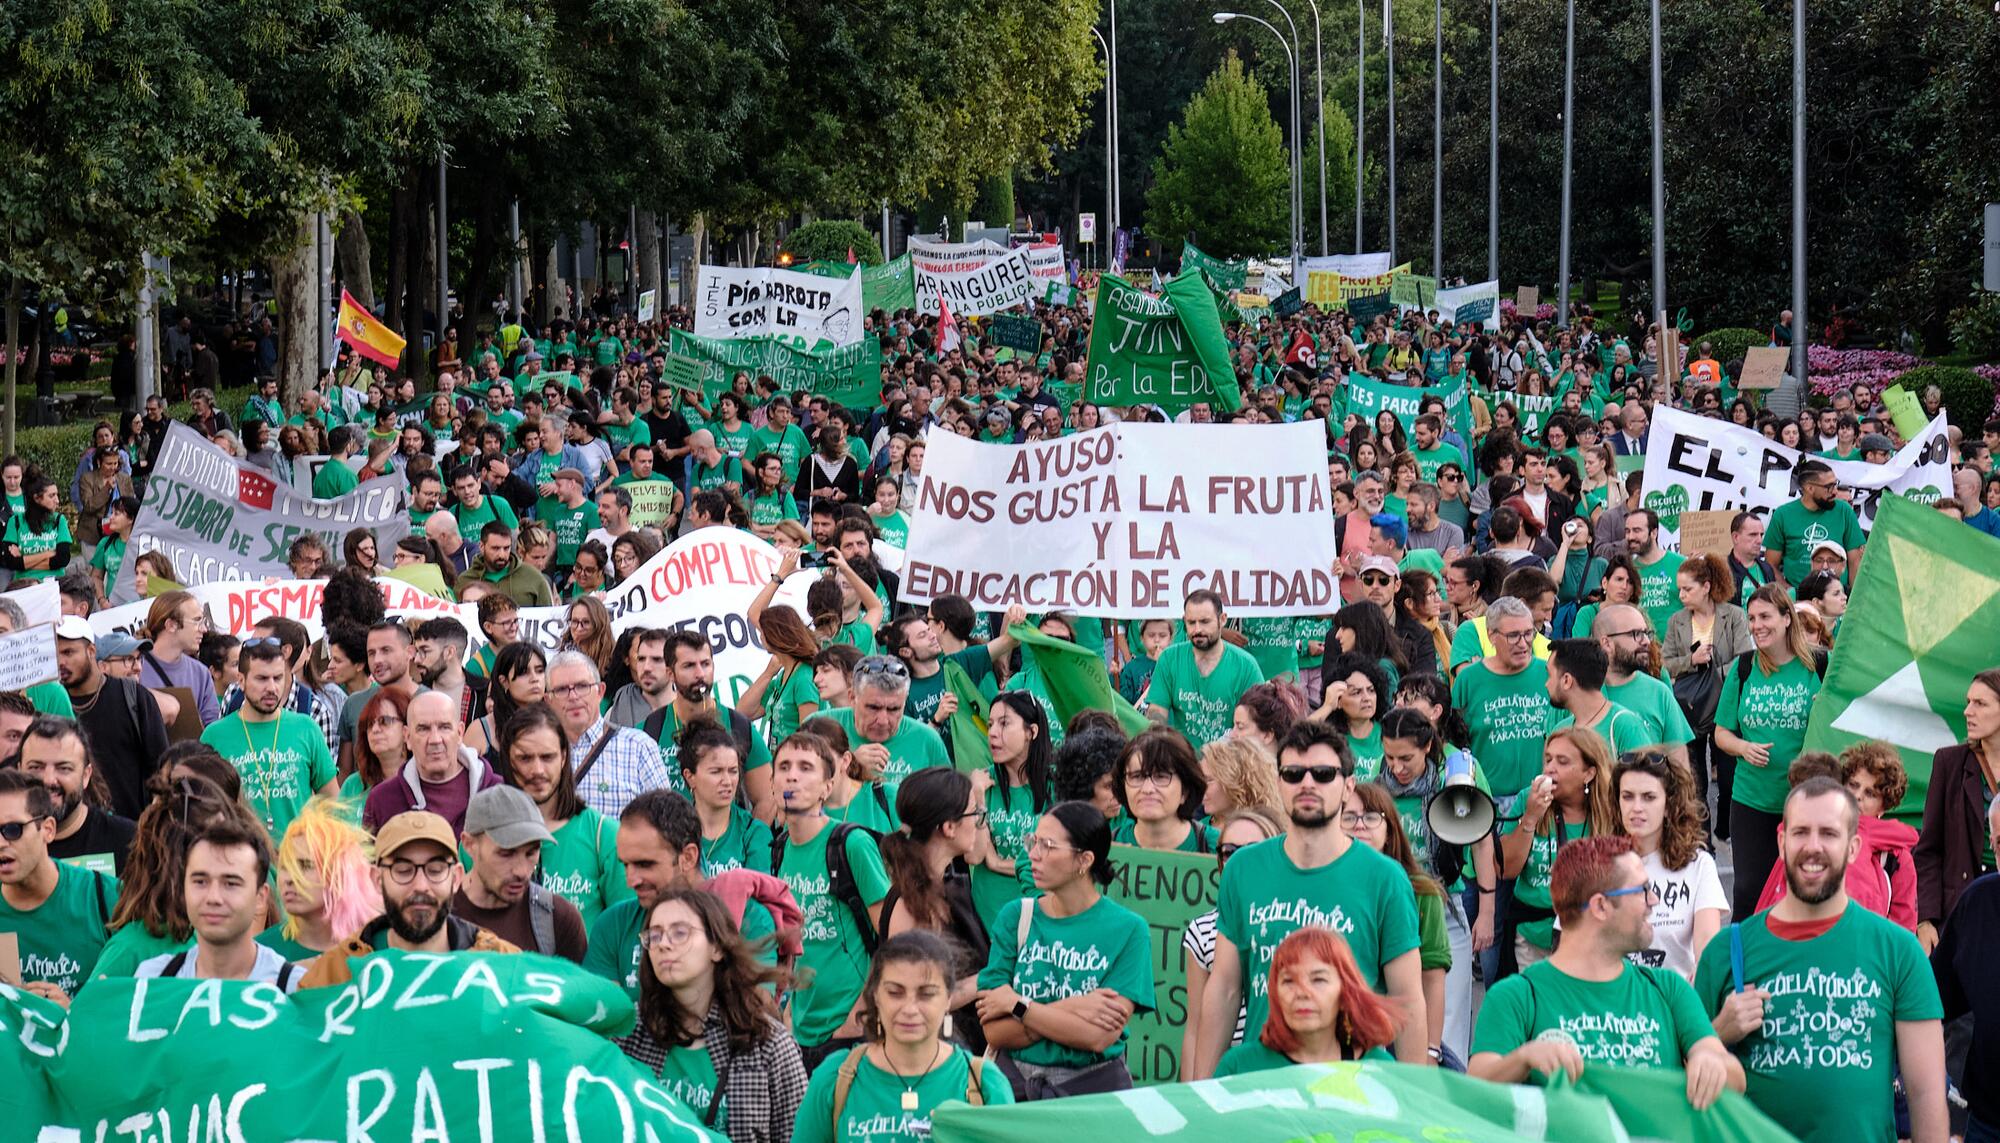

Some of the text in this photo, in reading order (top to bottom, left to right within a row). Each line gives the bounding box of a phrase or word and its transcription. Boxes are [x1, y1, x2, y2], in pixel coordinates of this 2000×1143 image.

[916, 249, 1032, 301] ARANGUREN
[955, 299, 973, 313] LA
[977, 280, 1037, 312] PÚBLICA
[727, 306, 799, 327] CON LA
[1094, 363, 1121, 400] Por
[1133, 361, 1158, 396] la
[1350, 383, 1375, 408] IES
[161, 433, 238, 498] INSTITUTO
[1006, 430, 1123, 484] AYUSO:
[1667, 432, 1735, 485] EL
[919, 472, 1325, 525] NOS GUSTA LA FRUTA
[228, 527, 254, 557] DE
[1092, 521, 1181, 561] Y LA
[905, 560, 1332, 608] EDUCACIÓN DE CALIDAD
[9, 634, 39, 648] PROFES
[1248, 898, 1301, 926] ESCUELA
[126, 977, 288, 1042] LAS
[1559, 1012, 1614, 1033] ESCUELA
[1762, 1016, 1793, 1039] DE
[1751, 1043, 1801, 1070] PARA
